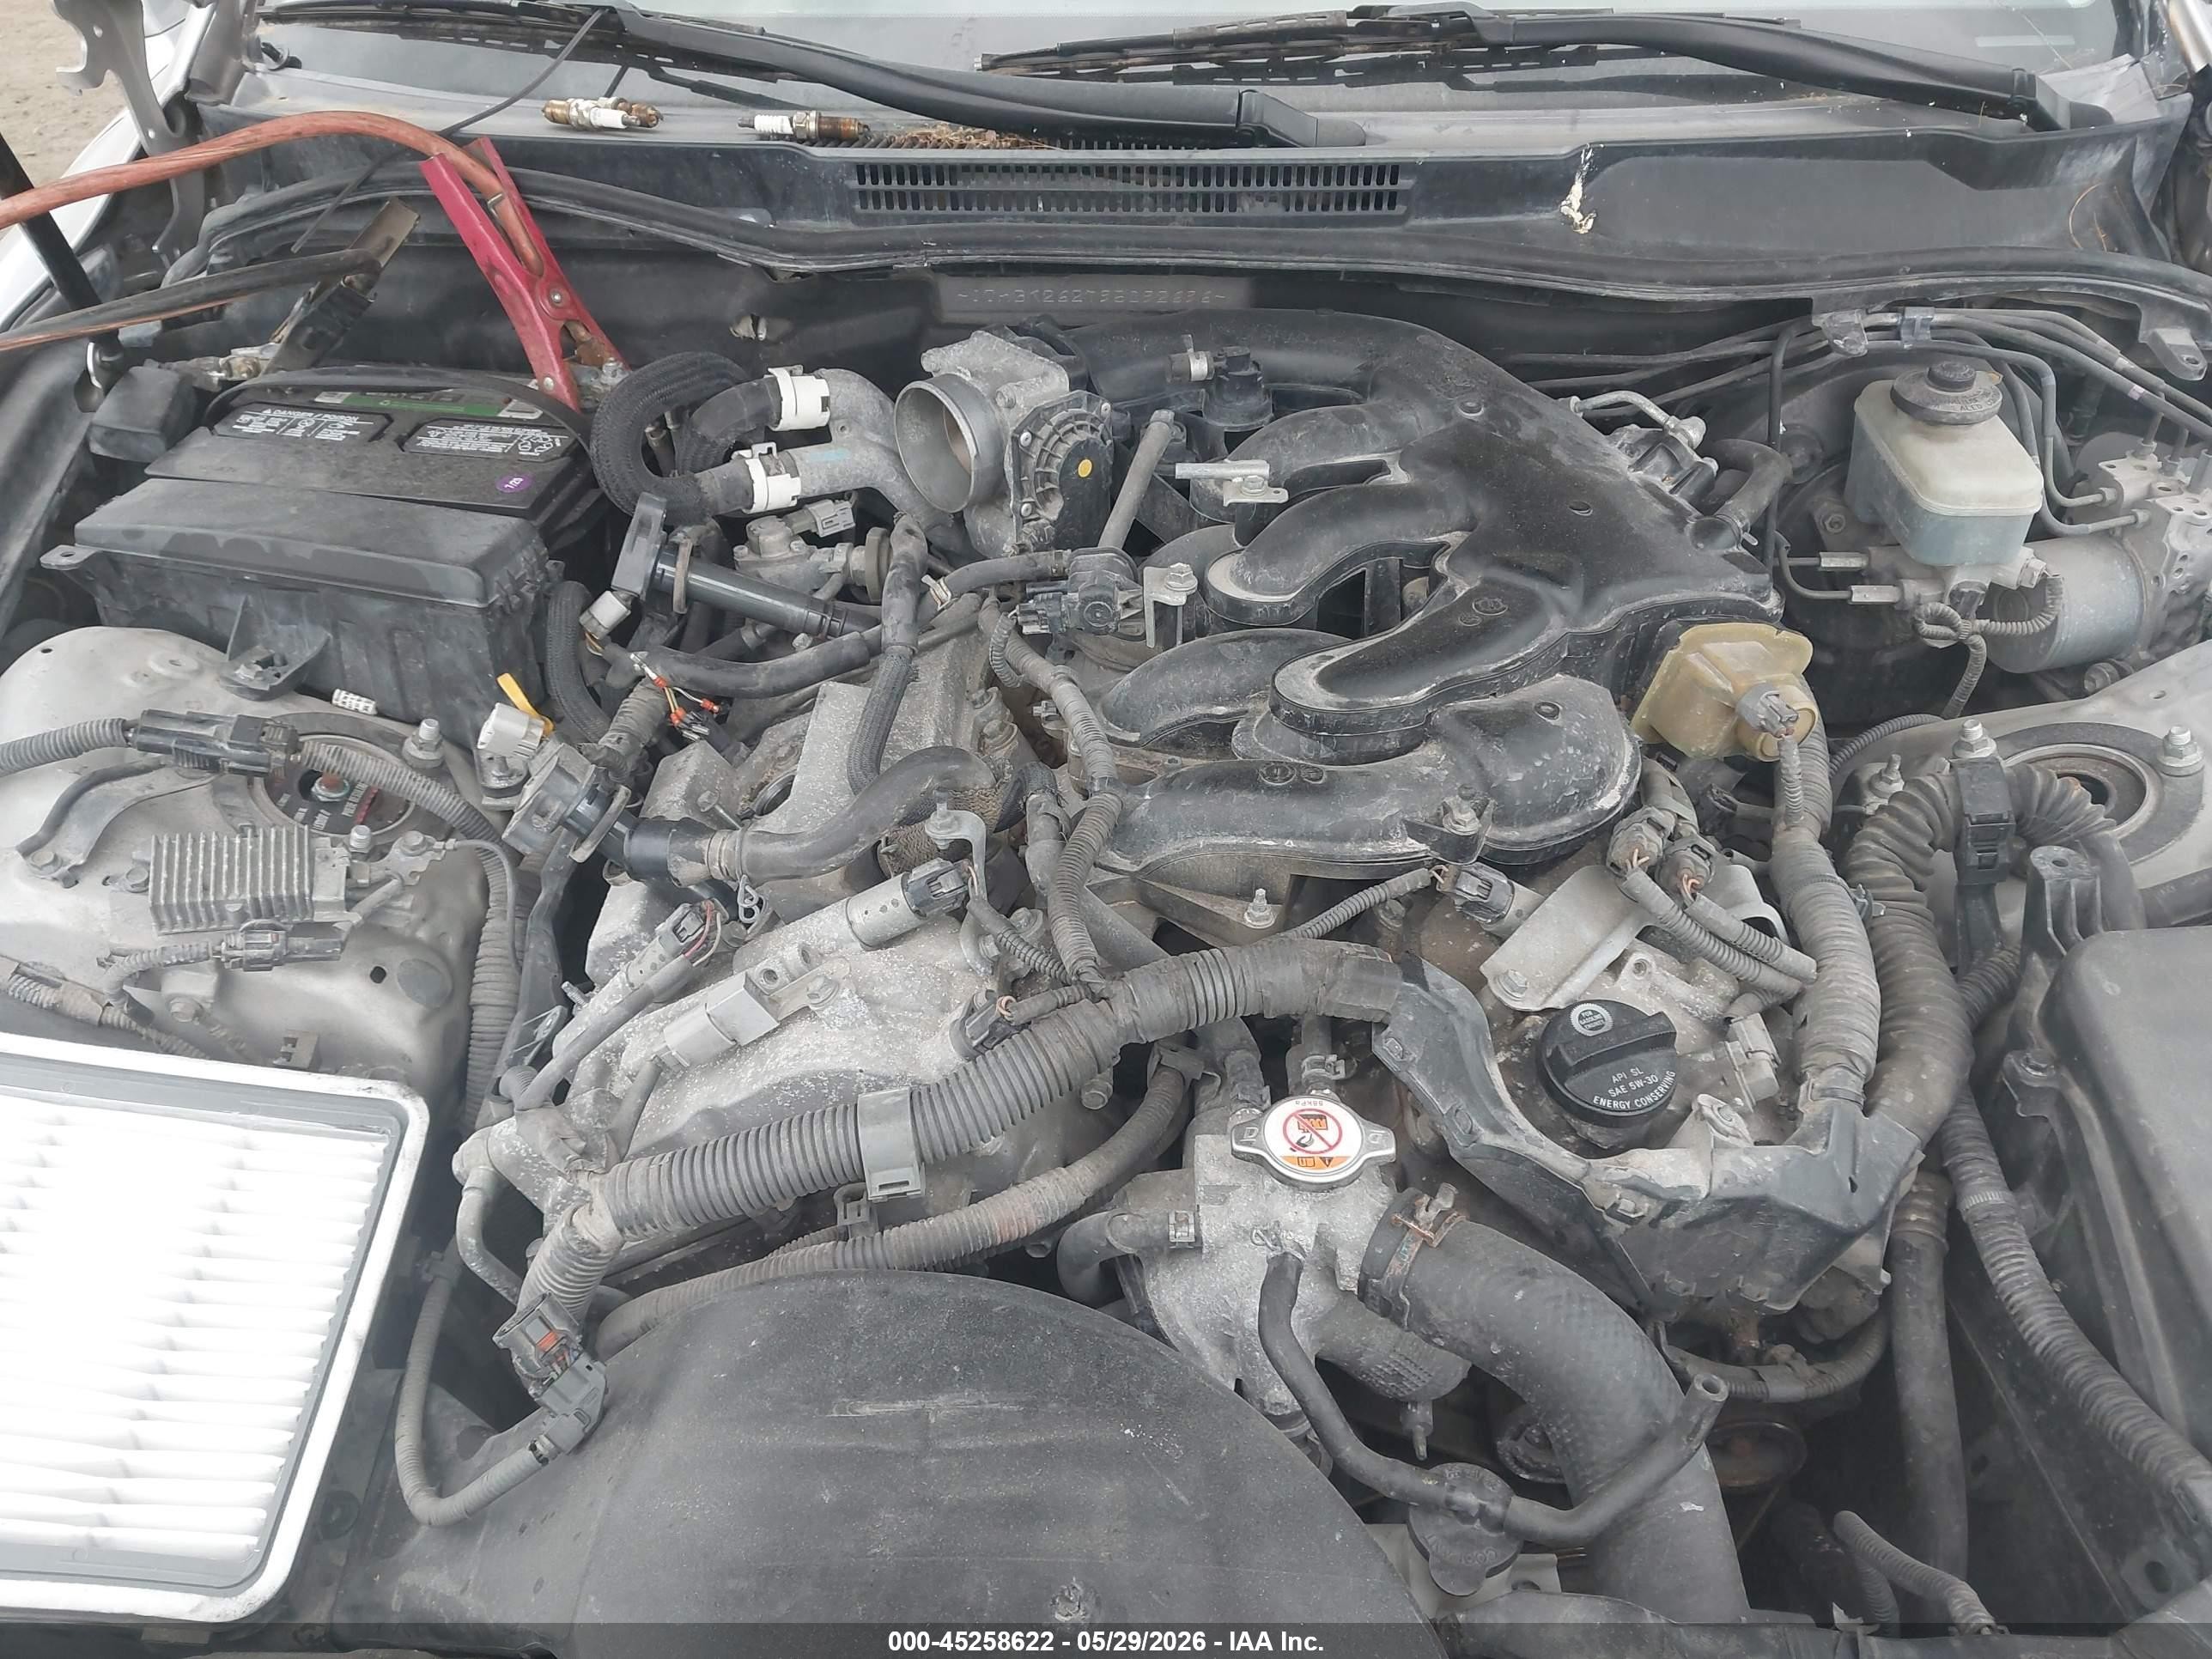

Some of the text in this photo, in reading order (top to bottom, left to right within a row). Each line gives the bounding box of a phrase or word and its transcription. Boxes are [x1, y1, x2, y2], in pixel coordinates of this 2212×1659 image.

[273, 409, 314, 417] DANGER
[321, 413, 360, 422] POISON
[1612, 1066, 1644, 1084] API SL
[1593, 1070, 1676, 1109] ENERGY CONSERVING
[1607, 1074, 1659, 1097] SAE 5W-30
